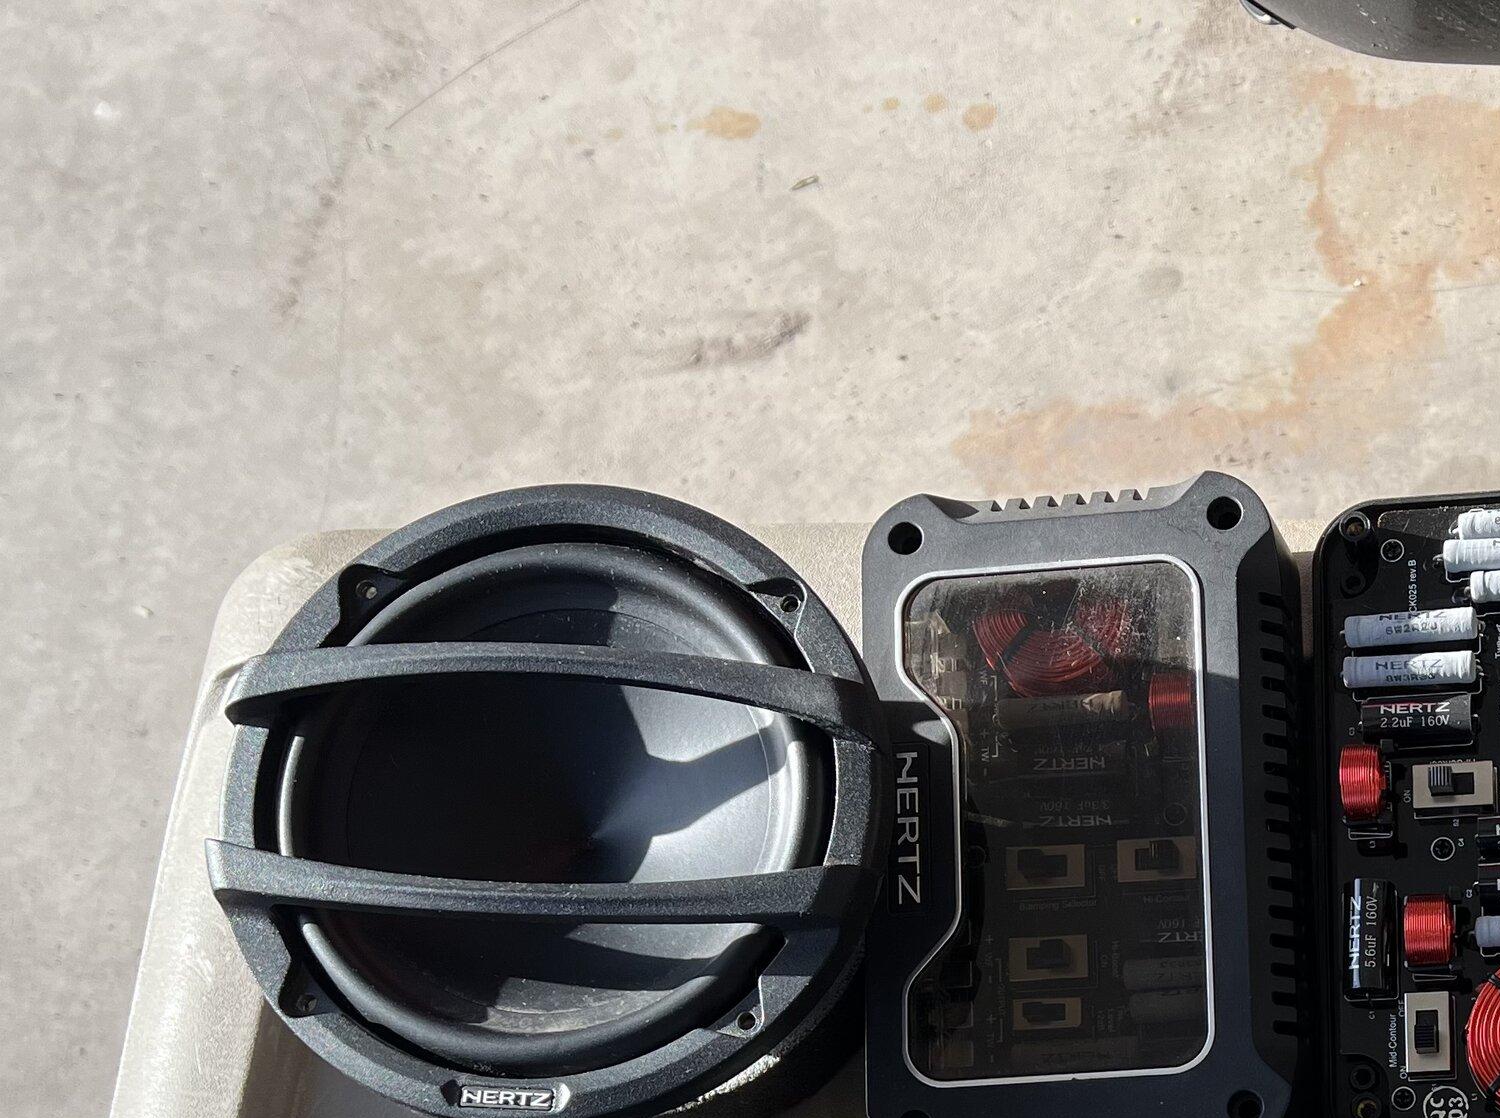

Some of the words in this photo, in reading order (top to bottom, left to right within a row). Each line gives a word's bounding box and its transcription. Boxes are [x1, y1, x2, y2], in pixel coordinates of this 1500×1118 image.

[1380, 702, 1450, 714] HERTZ
[1380, 717, 1413, 728] 2.2uF
[1422, 715, 1450, 726] 160V
[896, 751, 921, 905] HERTZ
[1365, 896, 1377, 925] 160V
[1349, 895, 1362, 969] HERTZ
[1365, 935, 1376, 968] 5.6uF
[463, 1089, 551, 1106] HERTZ
